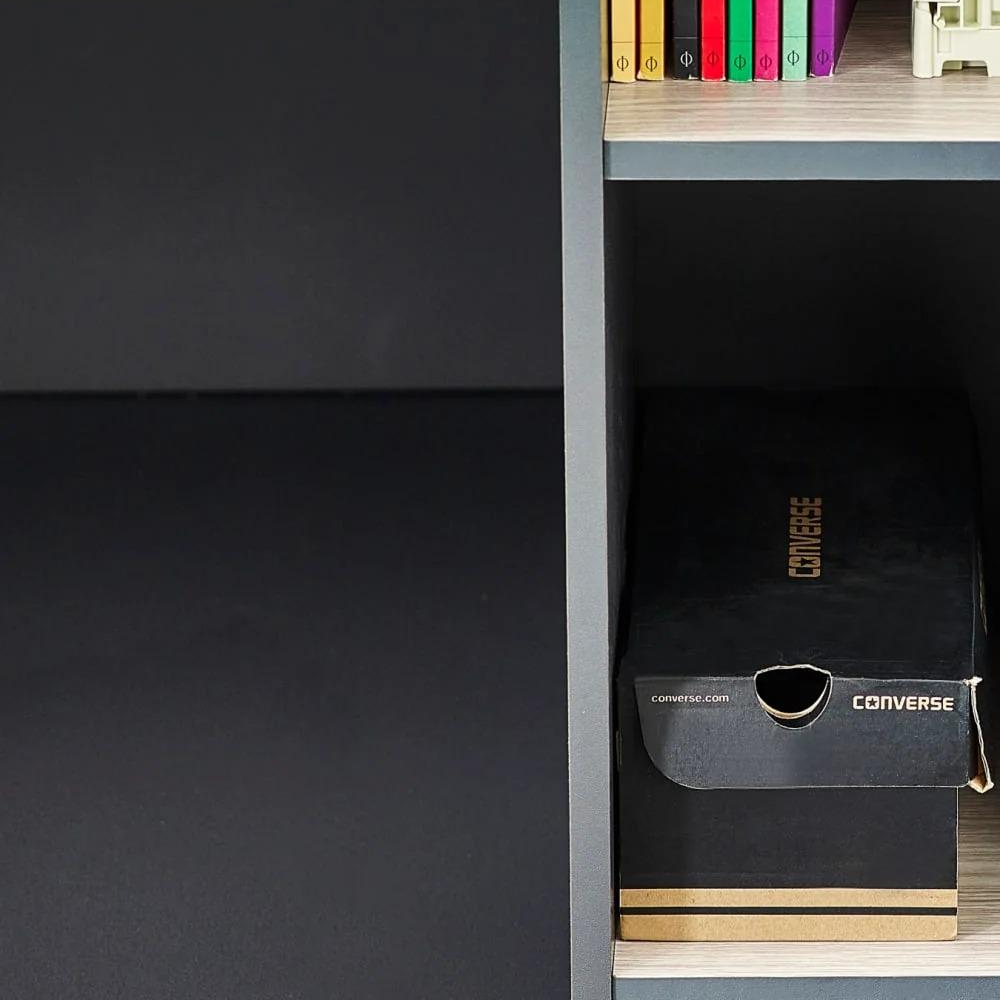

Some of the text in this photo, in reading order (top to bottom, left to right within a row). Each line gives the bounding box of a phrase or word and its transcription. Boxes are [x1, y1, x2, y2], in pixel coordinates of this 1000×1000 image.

[788, 497, 822, 578] CONVERSE
[651, 694, 730, 703] converse.com
[852, 695, 954, 711] CONVERSE
